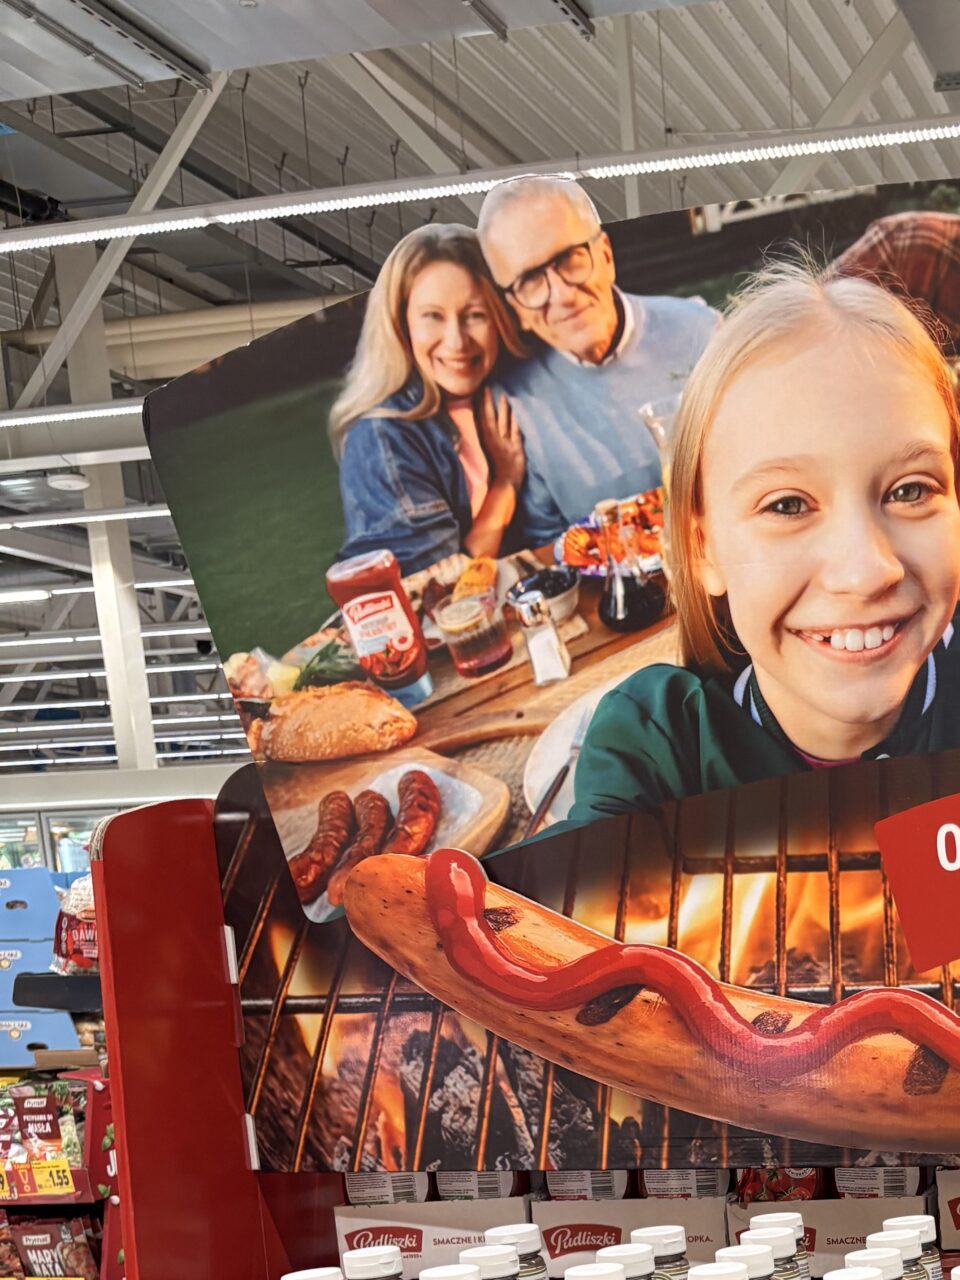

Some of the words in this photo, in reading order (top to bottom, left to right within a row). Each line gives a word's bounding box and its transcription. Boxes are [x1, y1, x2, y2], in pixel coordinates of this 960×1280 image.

[49, 1168, 70, 1187] 1.55
[432, 1236, 473, 1247] SMACZNE
[826, 1236, 866, 1246] SMACZNE
